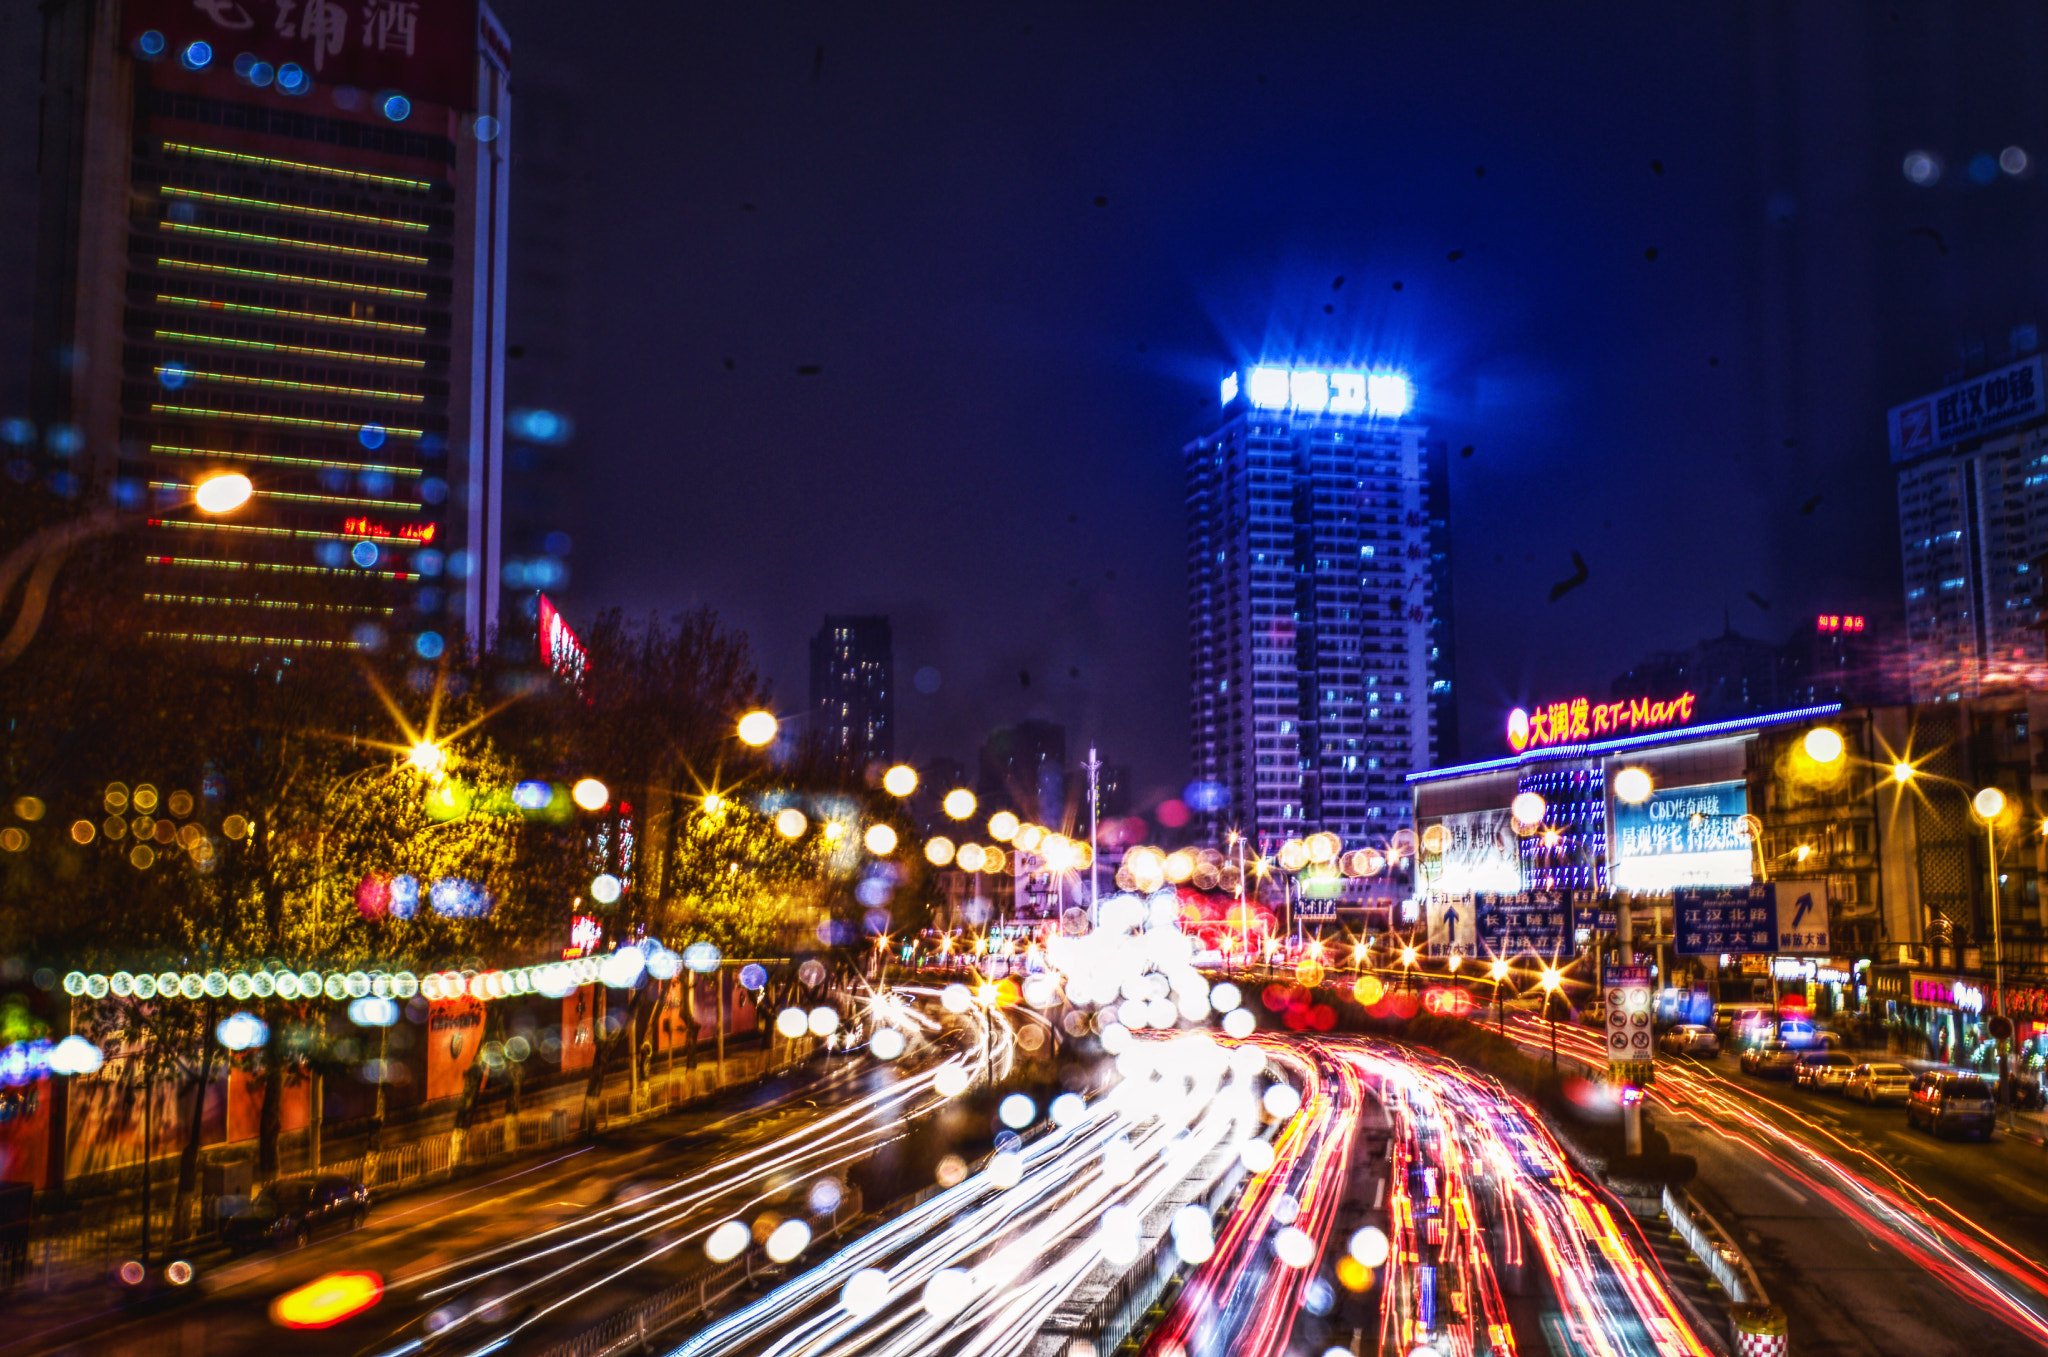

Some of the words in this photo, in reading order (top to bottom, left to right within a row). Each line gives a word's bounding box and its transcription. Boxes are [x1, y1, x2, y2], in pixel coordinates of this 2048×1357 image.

[1529, 696, 1591, 748] 大润发
[1592, 690, 1696, 736] RT-Mart
[1485, 913, 1565, 927] 长江隧道
[1684, 908, 1768, 922] 江汉北路
[1686, 931, 1769, 946] 京汉大道
[1780, 931, 1828, 947] 解放大道
[1431, 942, 1475, 957] 解放大道
